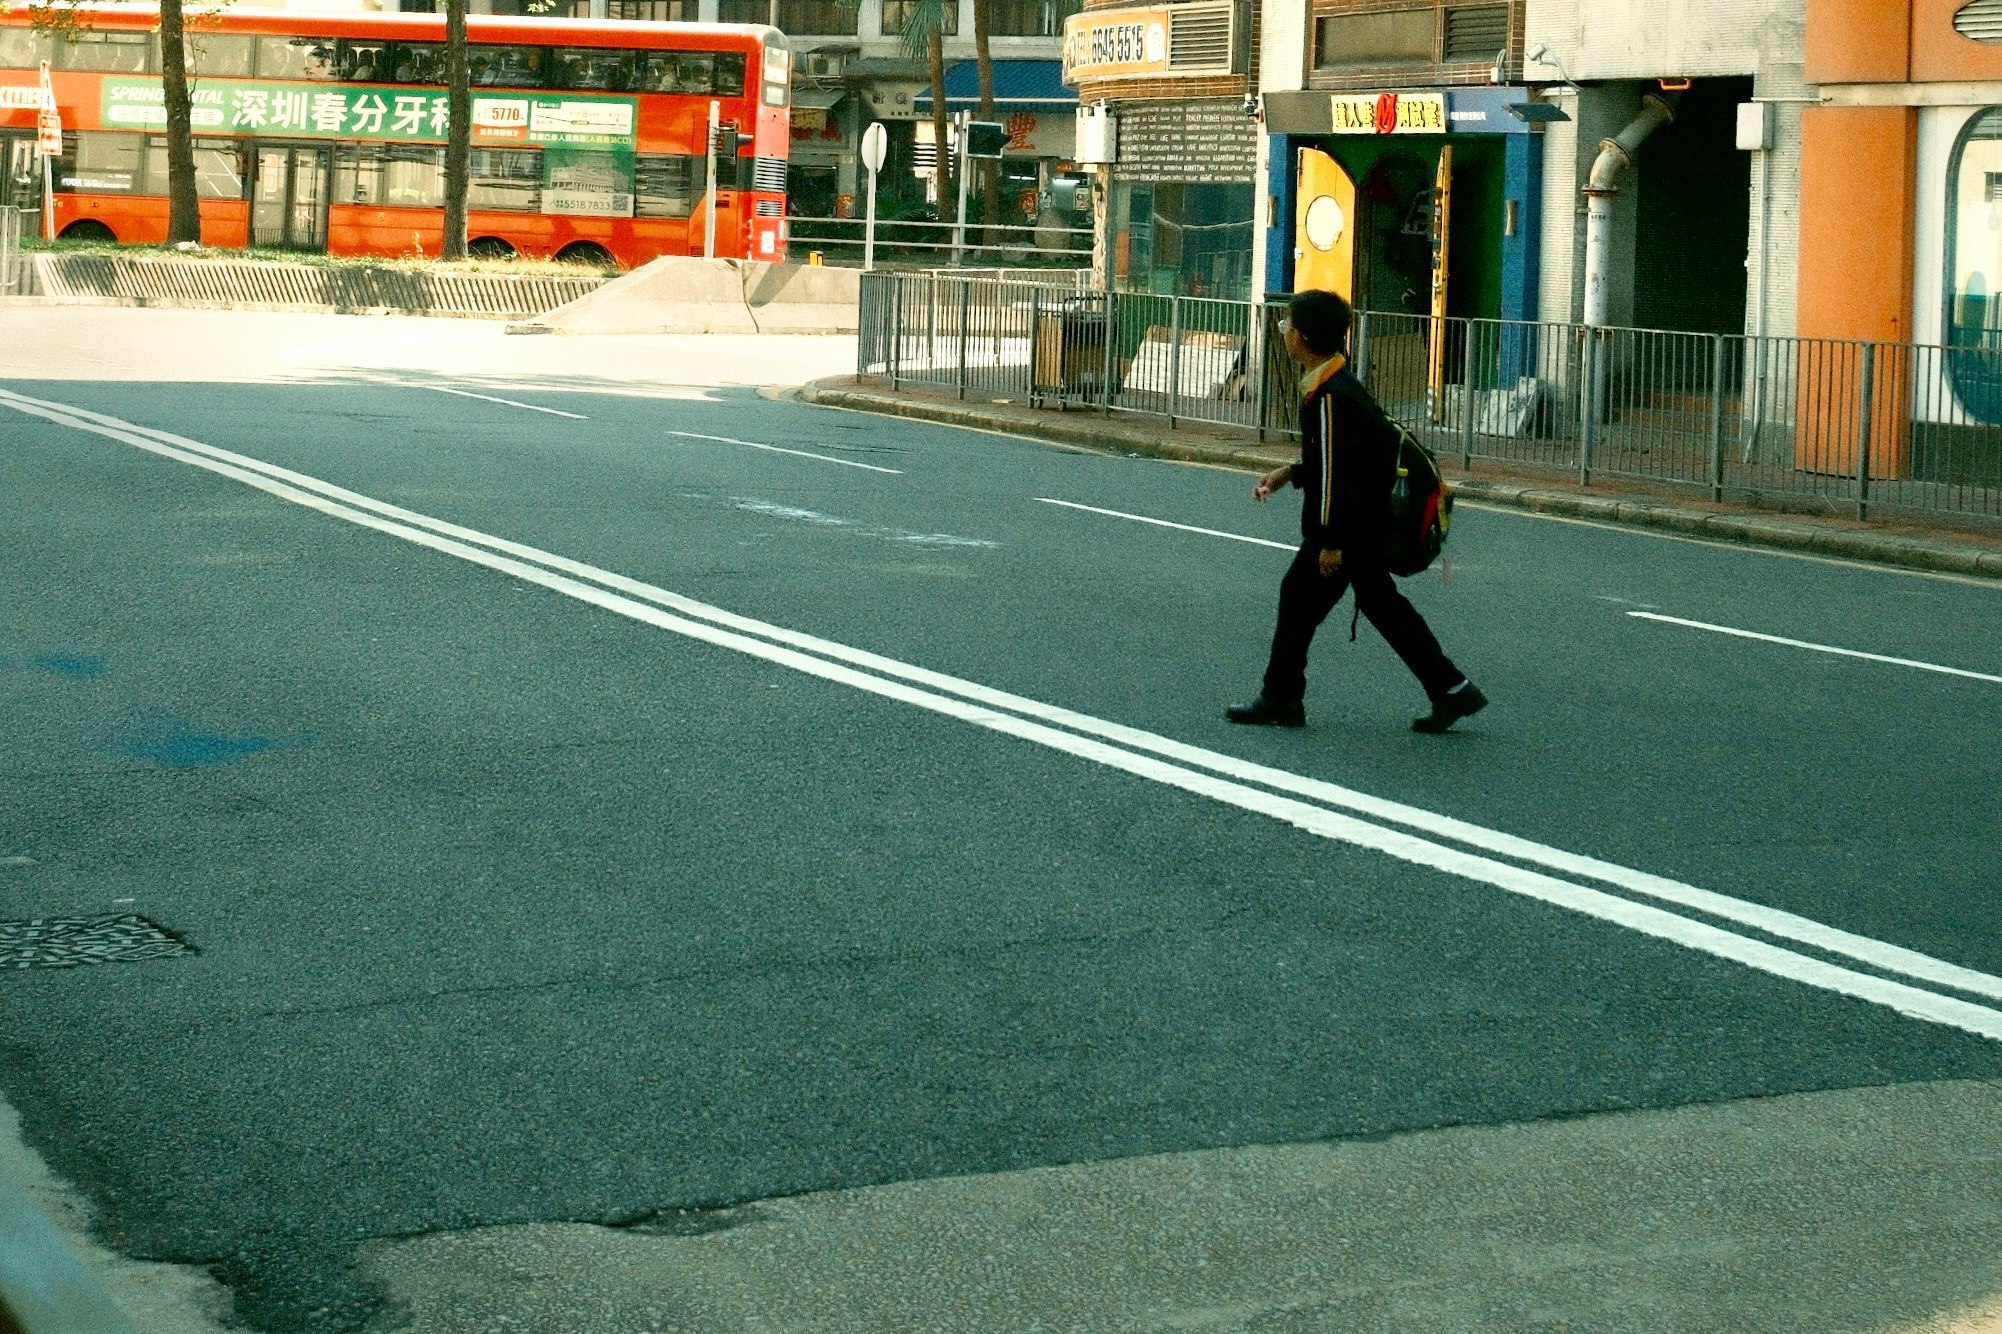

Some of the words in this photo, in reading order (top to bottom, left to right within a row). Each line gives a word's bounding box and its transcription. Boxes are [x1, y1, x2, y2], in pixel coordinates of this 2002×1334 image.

[1092, 27, 1115, 63] 6645
[492, 107, 520, 120] 5770
[564, 199, 585, 209] 5518
[588, 201, 611, 210] 7833
